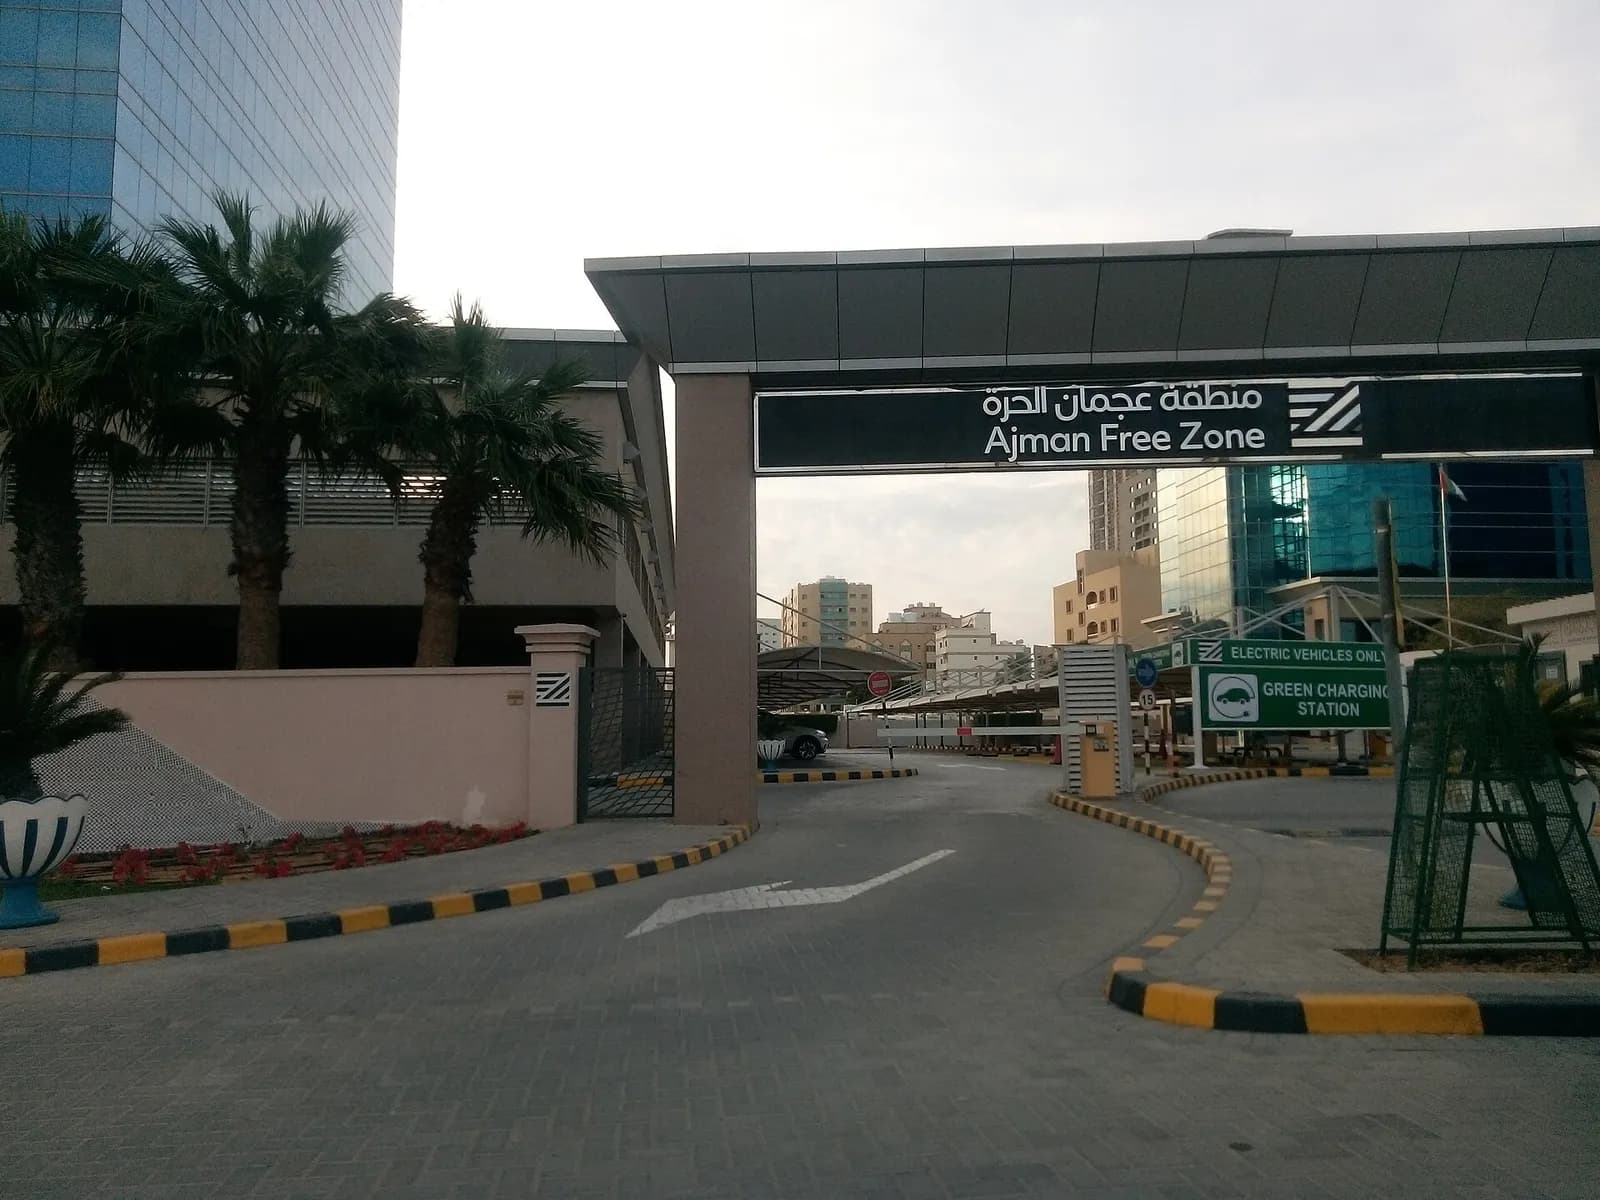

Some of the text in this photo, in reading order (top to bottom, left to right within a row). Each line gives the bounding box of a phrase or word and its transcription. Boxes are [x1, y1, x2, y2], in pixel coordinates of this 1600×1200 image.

[982, 381, 1262, 422] منطقة عجمان الحرة
[984, 421, 1265, 462] Ajman Free Zone
[1231, 646, 1290, 660] ELECTRIC
[1293, 648, 1353, 662] VEHICLES
[1263, 682, 1313, 697] GREEN
[1143, 694, 1153, 705] 15
[1298, 701, 1360, 716] STATION
